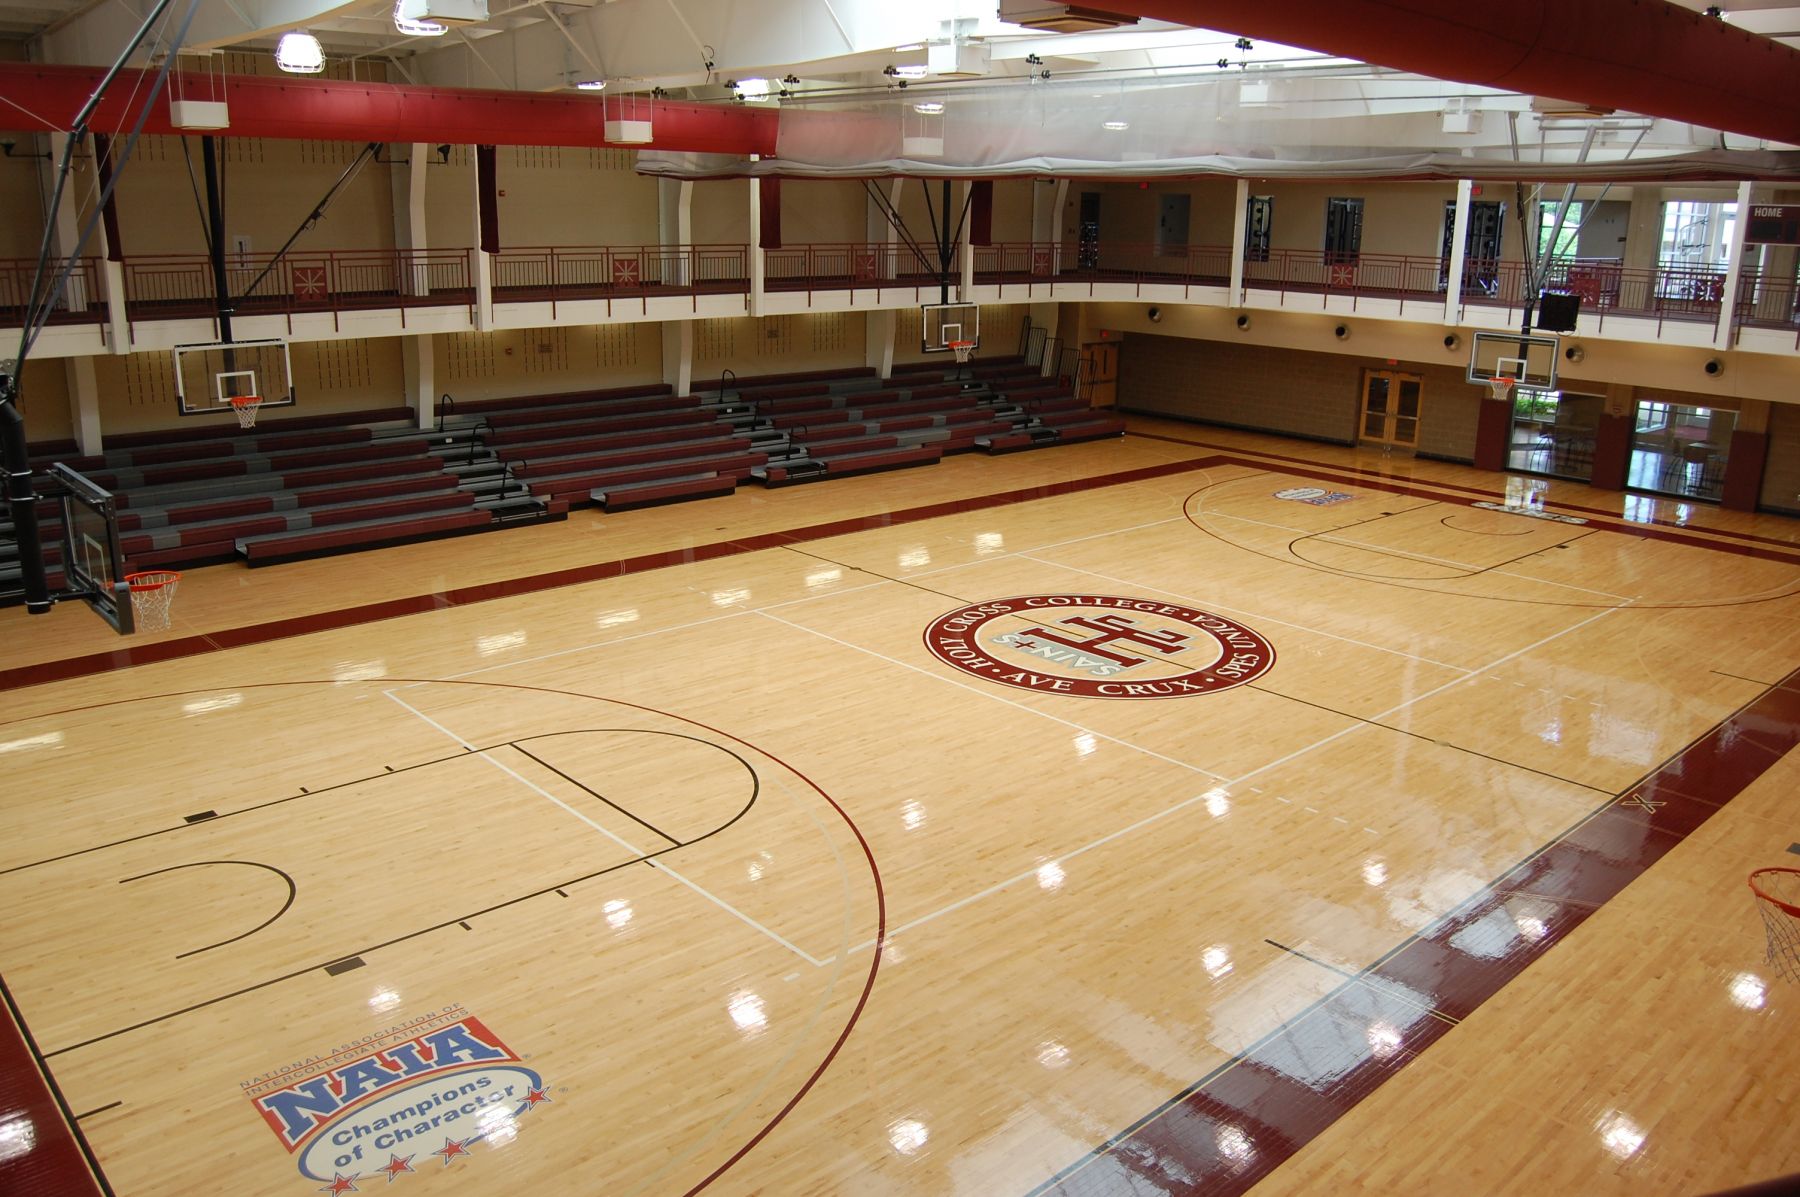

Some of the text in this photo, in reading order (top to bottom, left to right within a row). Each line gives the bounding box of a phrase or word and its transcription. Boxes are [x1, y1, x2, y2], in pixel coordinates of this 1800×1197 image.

[1754, 207, 1782, 217] HOME
[940, 596, 1180, 670] HOLY CROSS COLLEGE
[1190, 615, 1259, 678] SPES UNICA
[1000, 671, 1204, 697] AVE CRUX
[239, 1002, 461, 1088] NATIONAL ASSOCIATION OF
[245, 1009, 469, 1097] INTERCOLLEGIATE ATHLETICS
[263, 1024, 503, 1140] NAIA
[332, 1075, 492, 1146] Champions
[334, 1083, 514, 1168] of Character
